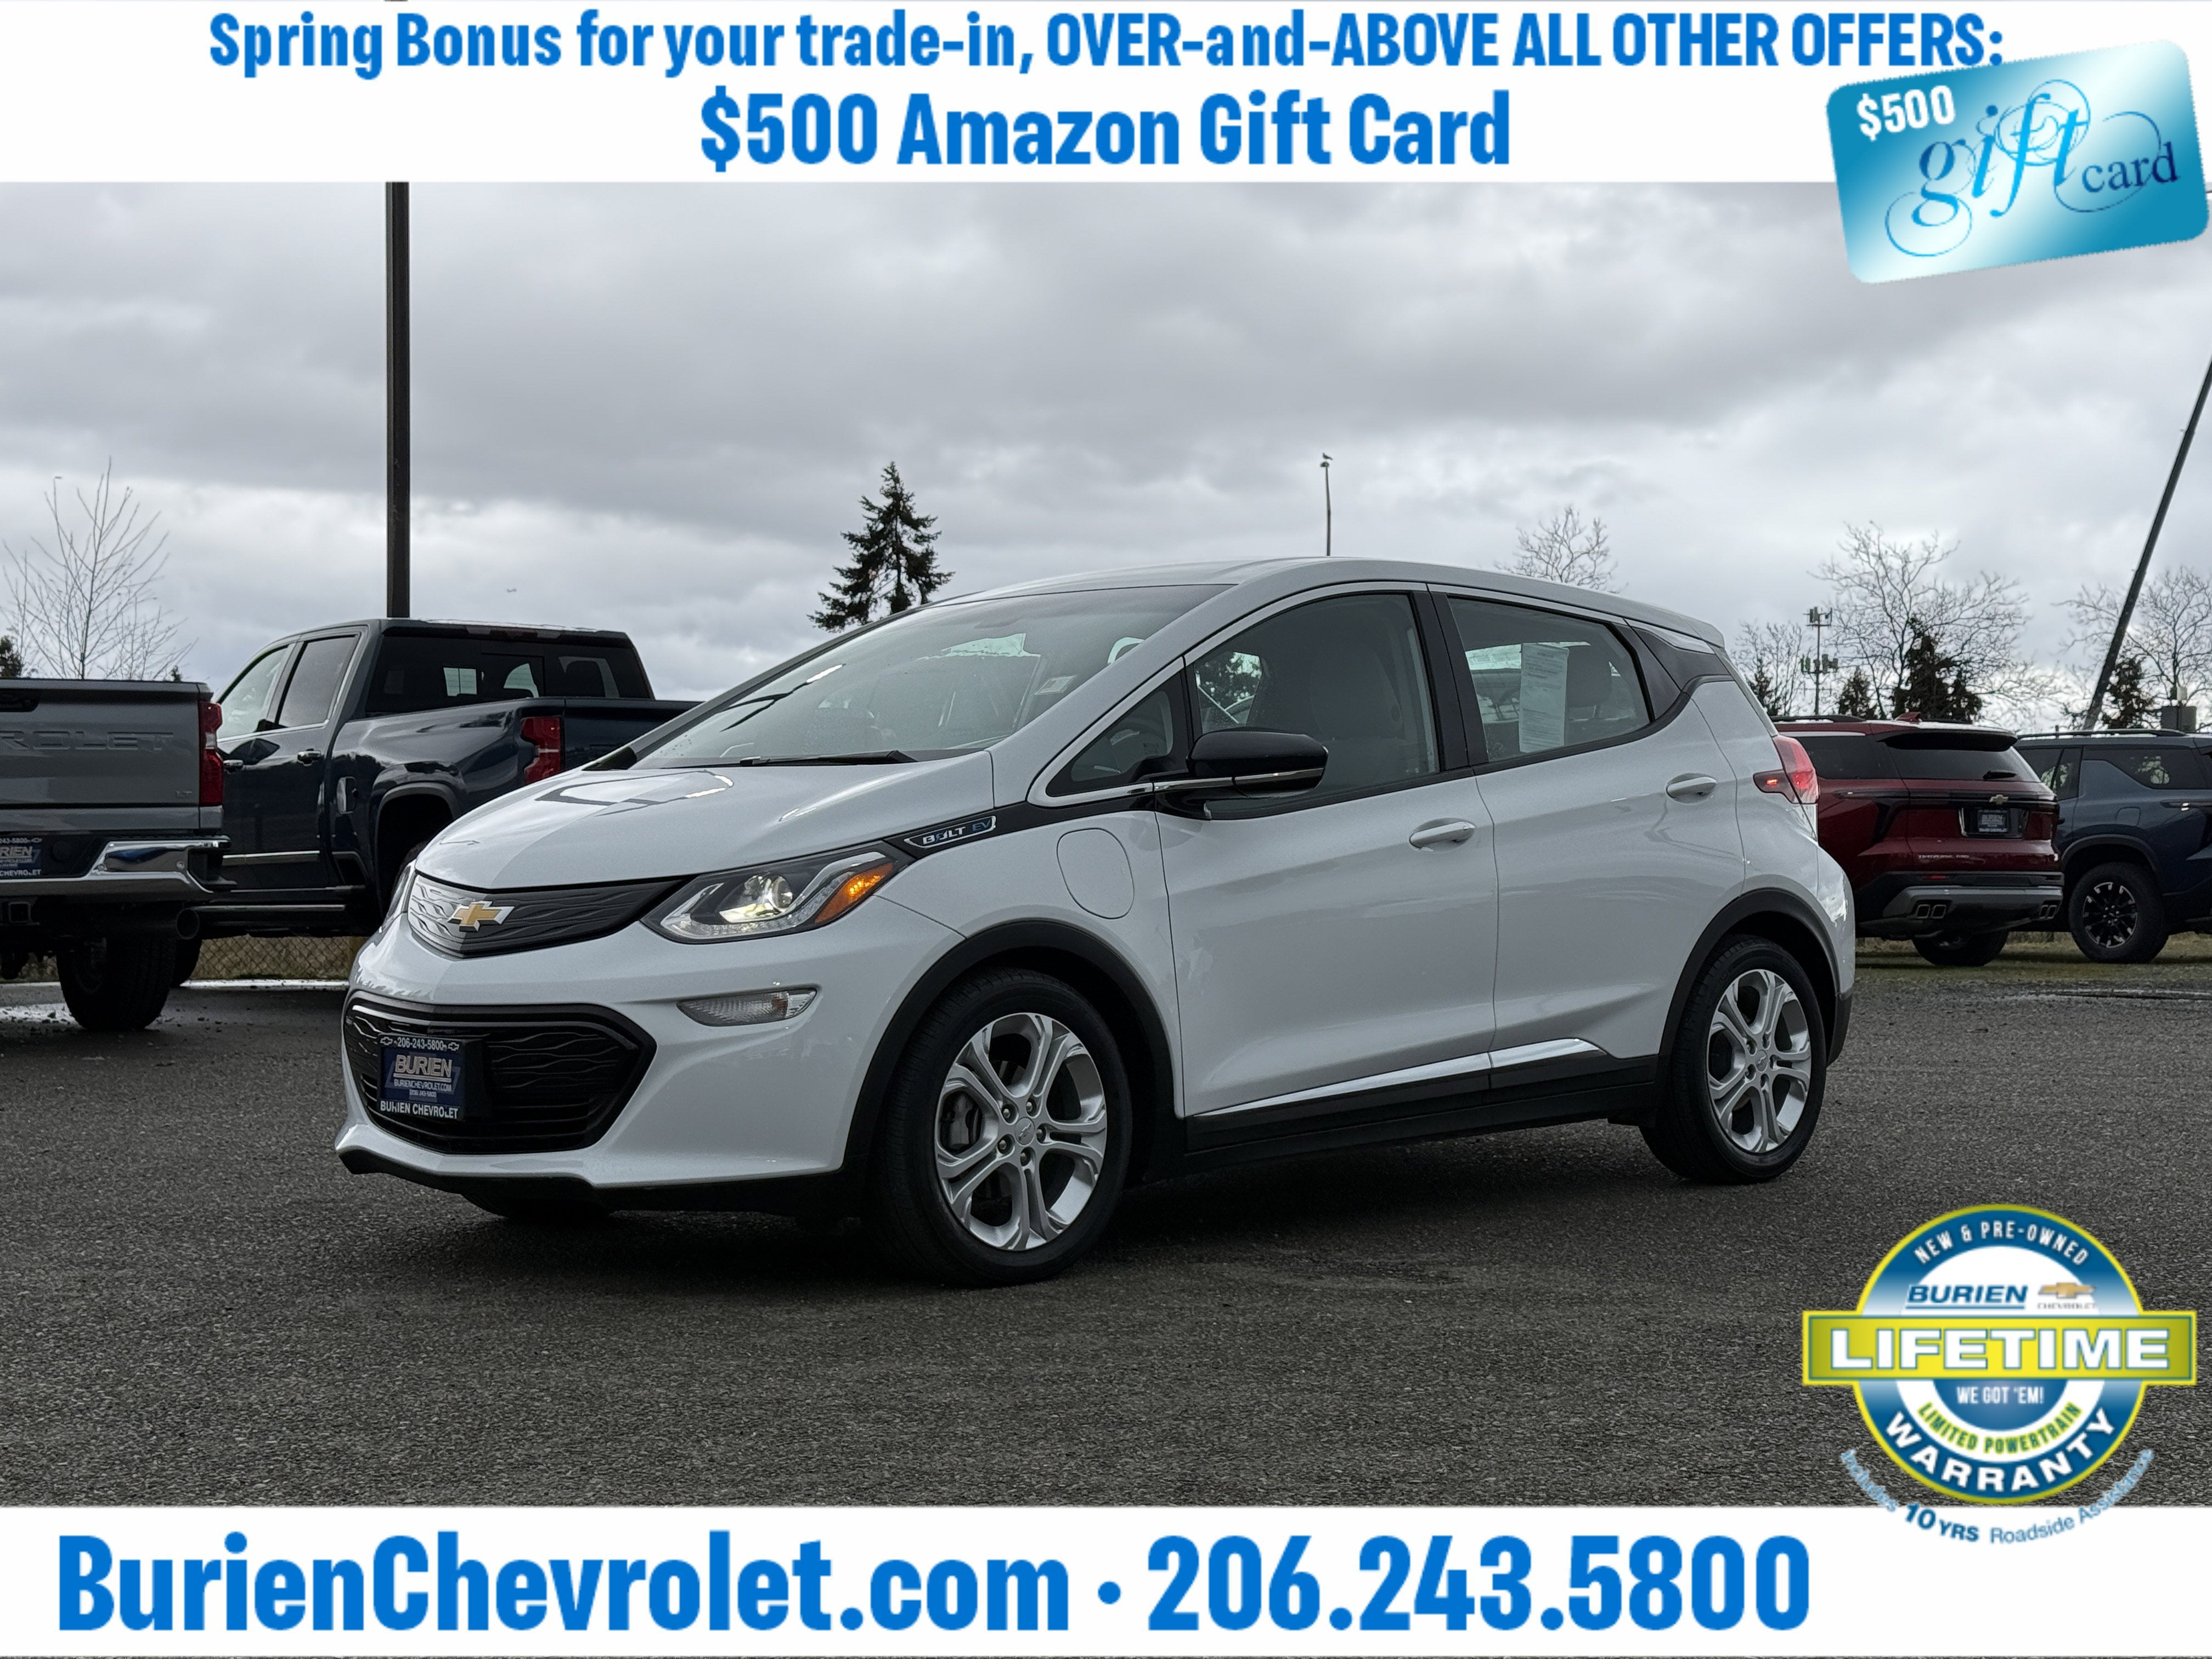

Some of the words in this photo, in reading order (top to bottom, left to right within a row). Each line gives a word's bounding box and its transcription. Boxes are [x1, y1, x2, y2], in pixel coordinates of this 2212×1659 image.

[923, 826, 966, 845] BOLT
[972, 820, 991, 832] EV
[395, 1054, 453, 1077] BURIEN
